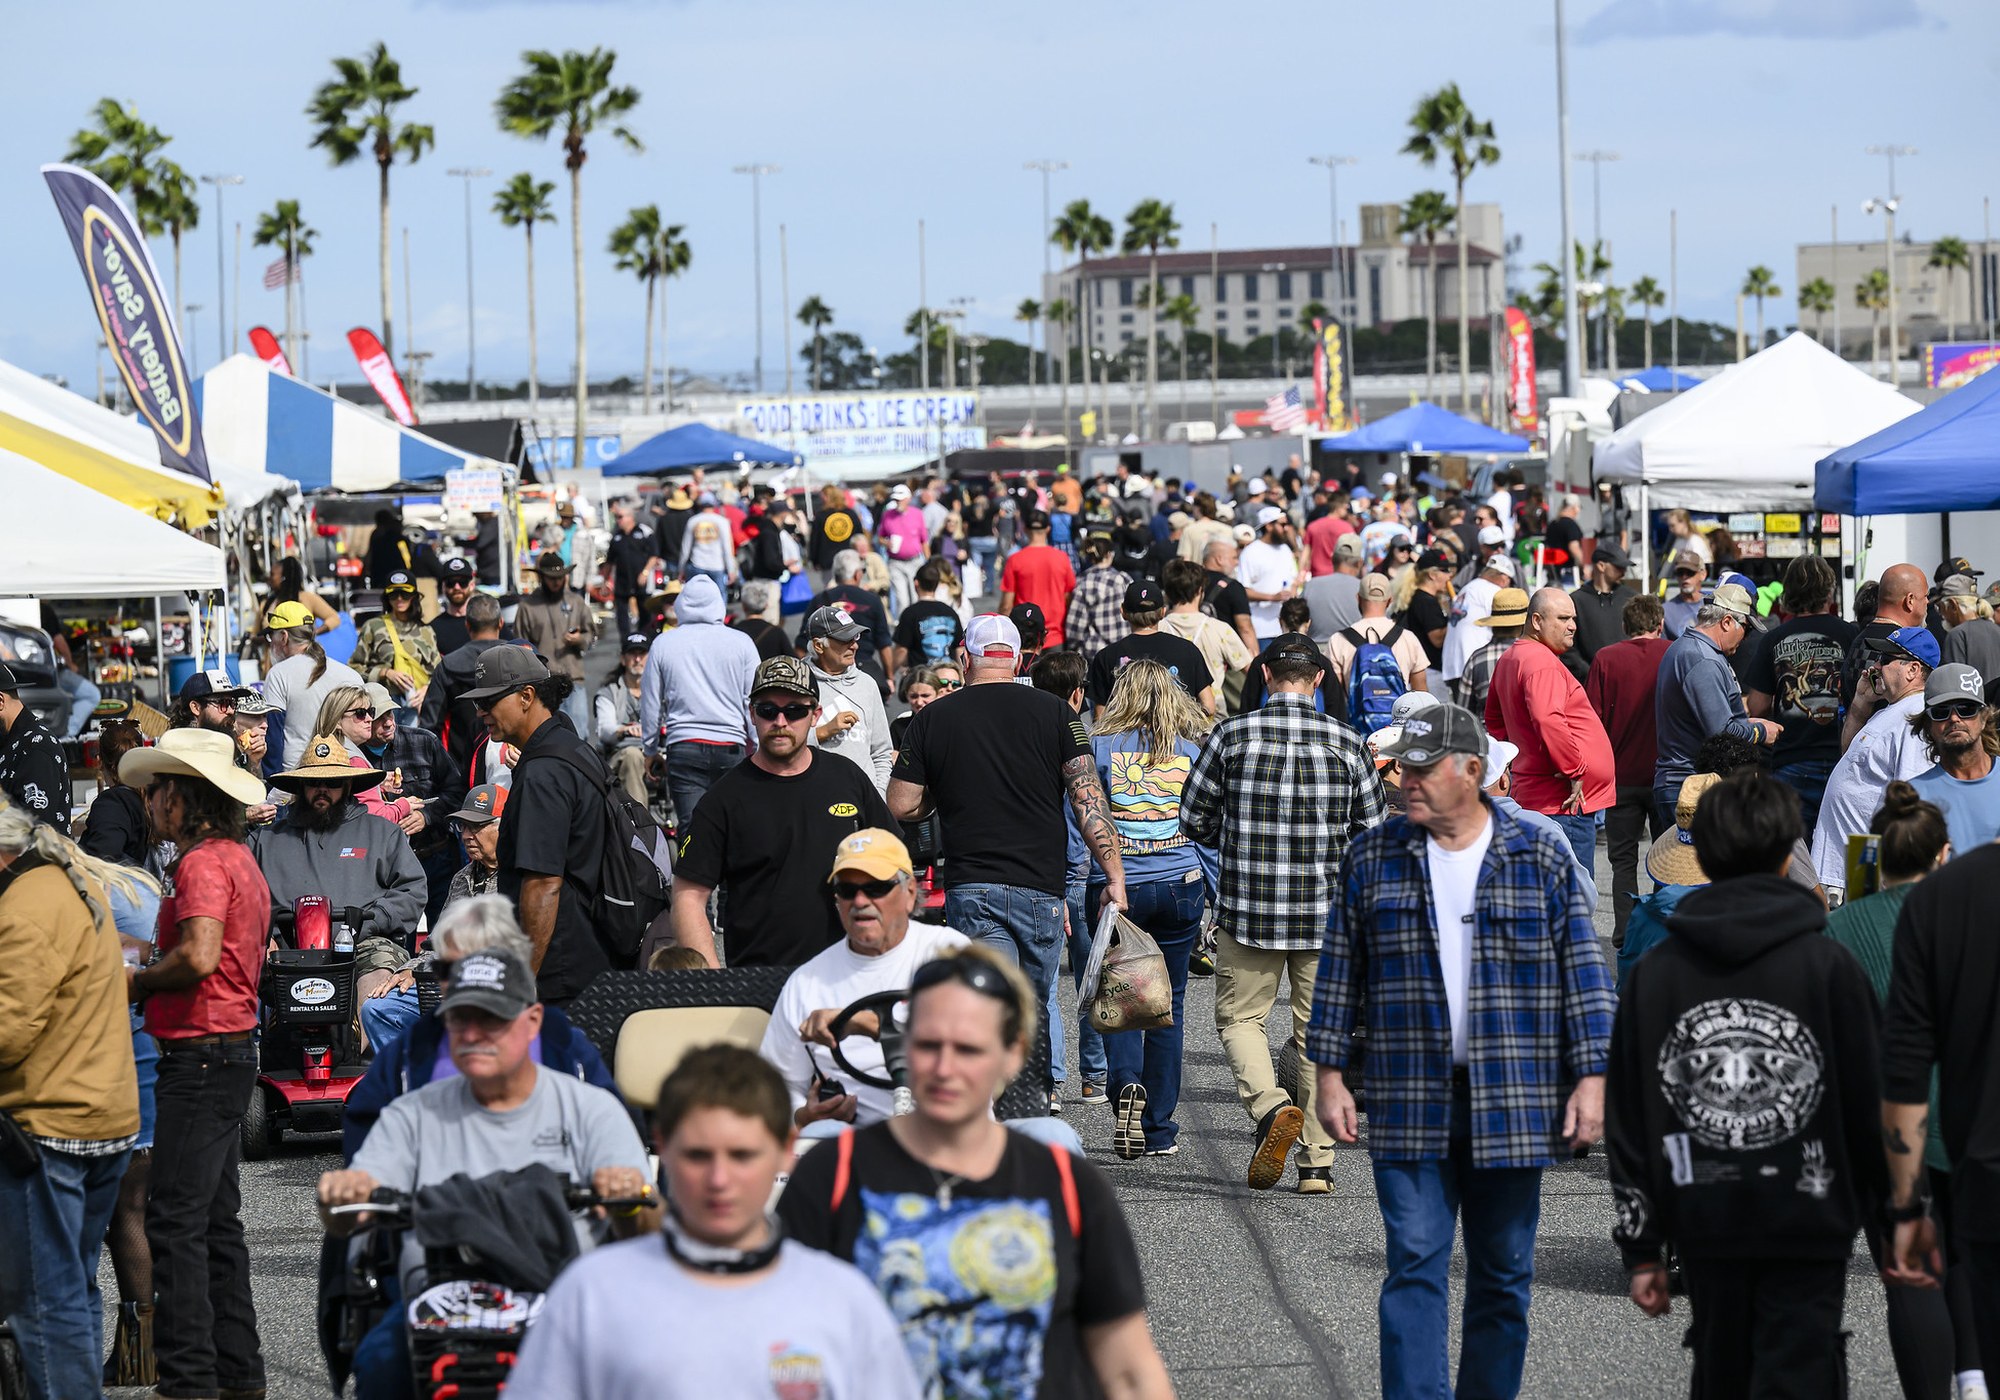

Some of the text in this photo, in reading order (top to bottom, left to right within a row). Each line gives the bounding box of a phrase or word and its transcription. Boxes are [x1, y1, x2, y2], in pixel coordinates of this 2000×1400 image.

[744, 397, 976, 432] FOOD DRINKS ICE CREAM
[832, 804, 855, 815] XDP
[1094, 826, 1117, 861] 1776
